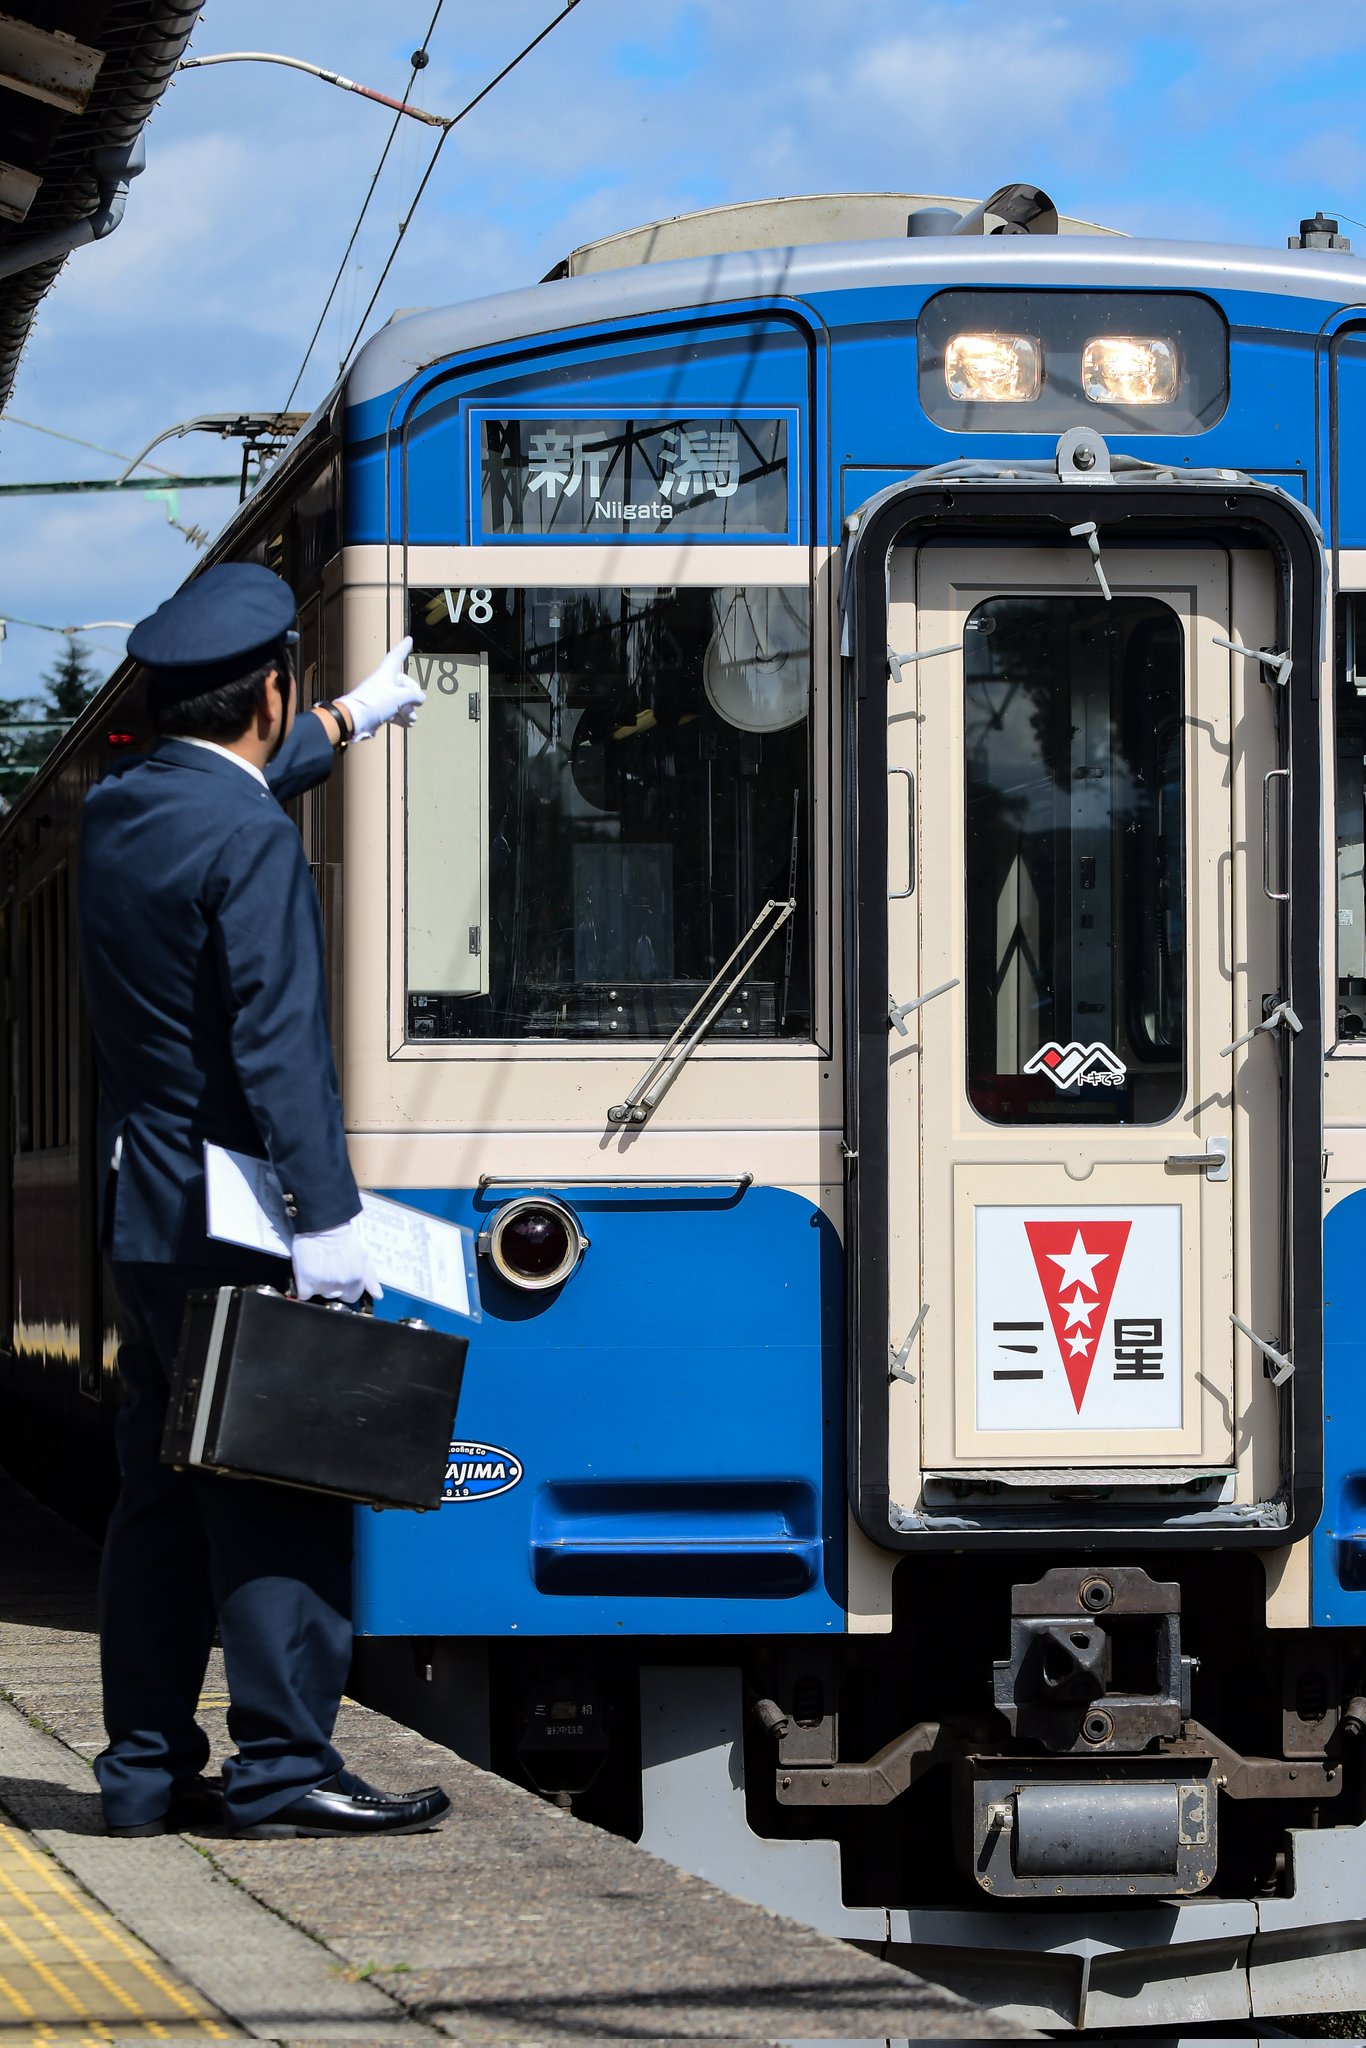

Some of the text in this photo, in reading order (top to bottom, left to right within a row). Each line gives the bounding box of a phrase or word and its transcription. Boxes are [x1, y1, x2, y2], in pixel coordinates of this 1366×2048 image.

[527, 428, 740, 498] 新潟
[594, 500, 673, 519] Niigata
[443, 588, 494, 624] V8
[1077, 1071, 1125, 1086] トキてつ
[448, 1445, 487, 1456] oofing Co
[444, 1463, 506, 1486] AJIMA
